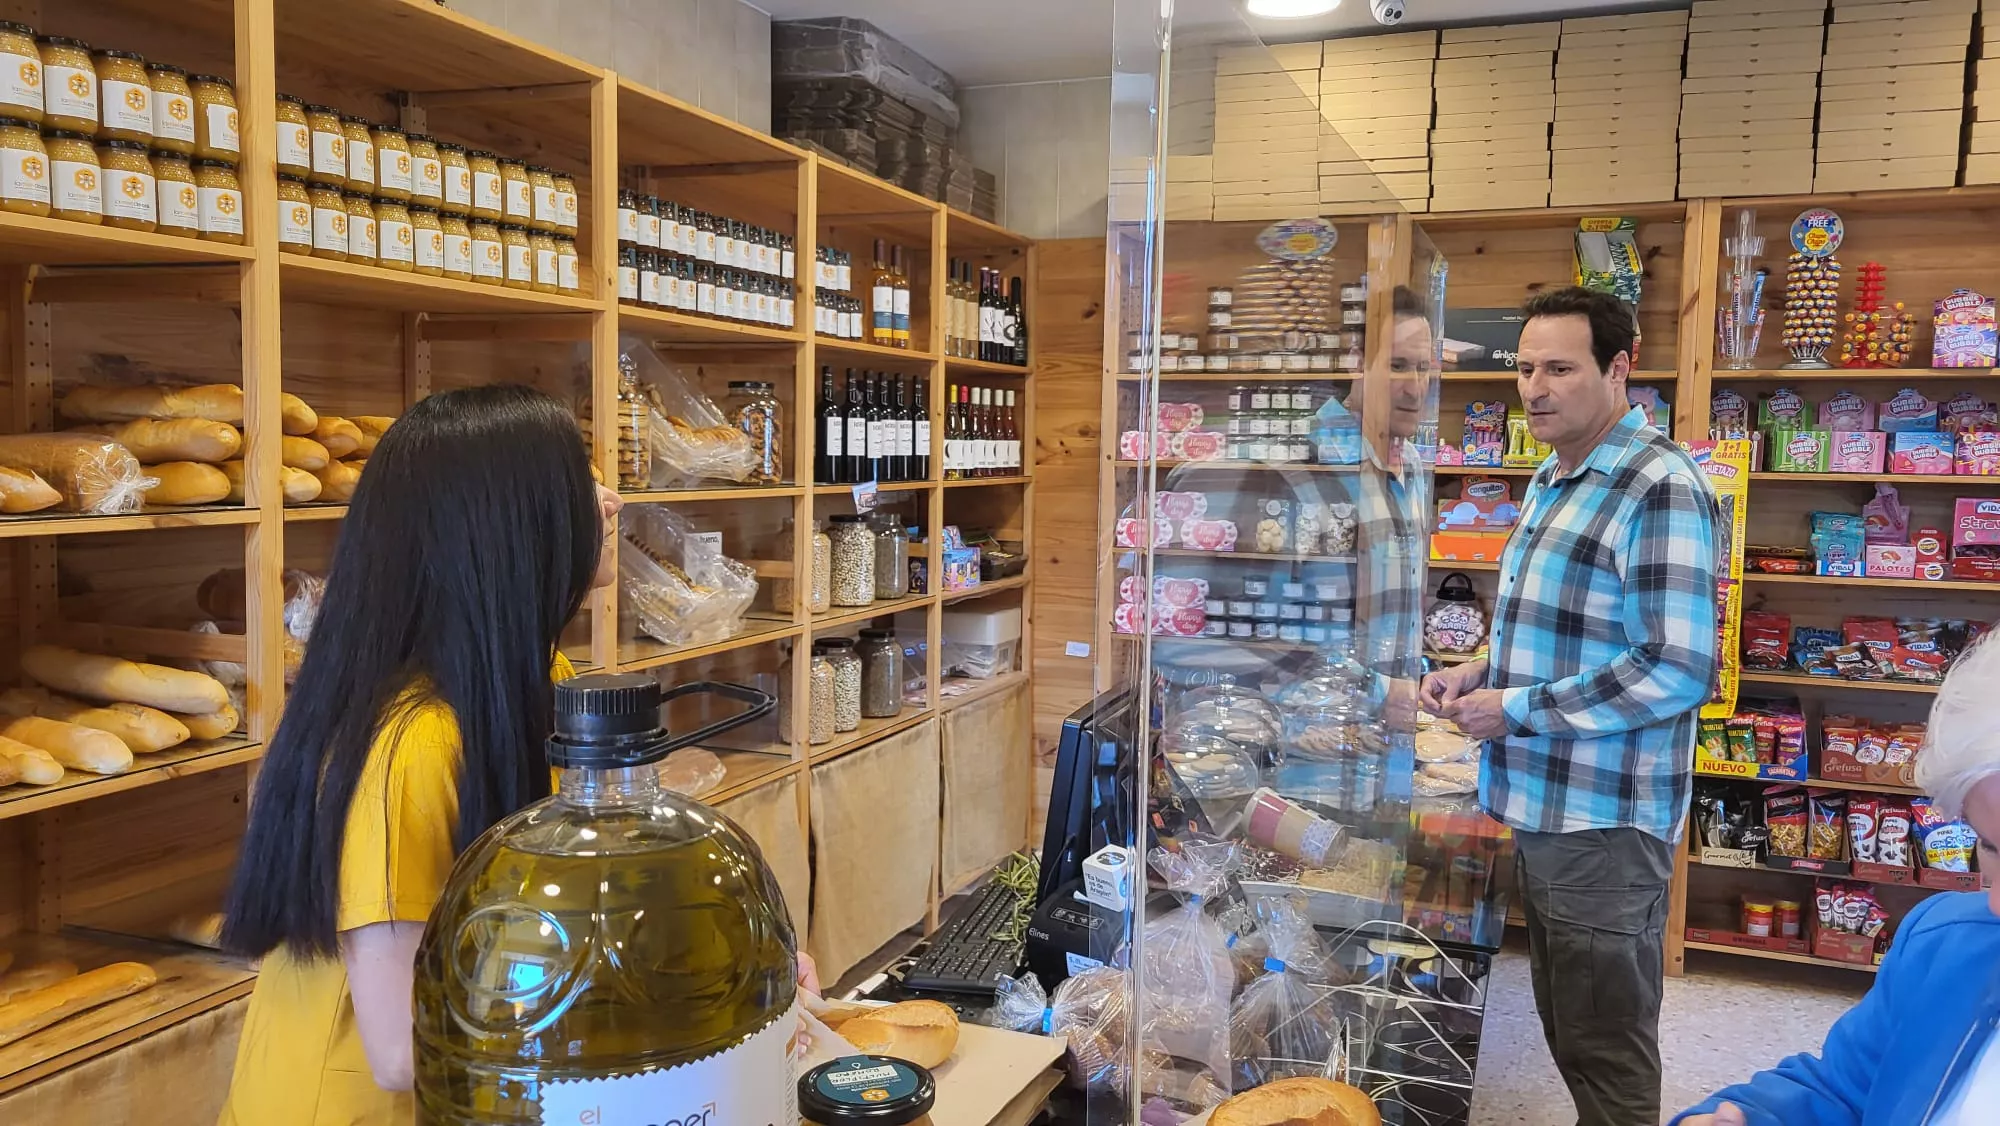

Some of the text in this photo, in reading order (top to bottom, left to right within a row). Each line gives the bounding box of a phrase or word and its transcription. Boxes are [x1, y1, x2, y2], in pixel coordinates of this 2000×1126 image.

[1807, 220, 1829, 228] FREE
[1944, 295, 1980, 305] DUBBLE
[1946, 301, 1981, 310] BUBBLE
[1769, 397, 1800, 406] DUBBLE
[1830, 397, 1866, 407] DUBBLE
[1891, 398, 1924, 408] DUBBLE
[1771, 403, 1801, 411] BUBBLE
[1831, 402, 1866, 412] BUBBLE
[1892, 404, 1925, 413] BUBBLE
[1724, 442, 1741, 452] 1+1
[1840, 440, 1870, 449] DUBBLE
[1842, 446, 1872, 454] BUBBLE
[1715, 451, 1747, 459] GRATIS
[1469, 484, 1504, 494] conguitas
[1869, 564, 1911, 573] PALOTES
[1177, 611, 1201, 623] Happy
[1865, 640, 1889, 649] VIDAL
[1909, 642, 1932, 651] VIDAL
[1703, 761, 1747, 773] NUEVO
[1824, 763, 1862, 773] Grefusa
[579, 1105, 601, 1125] el
